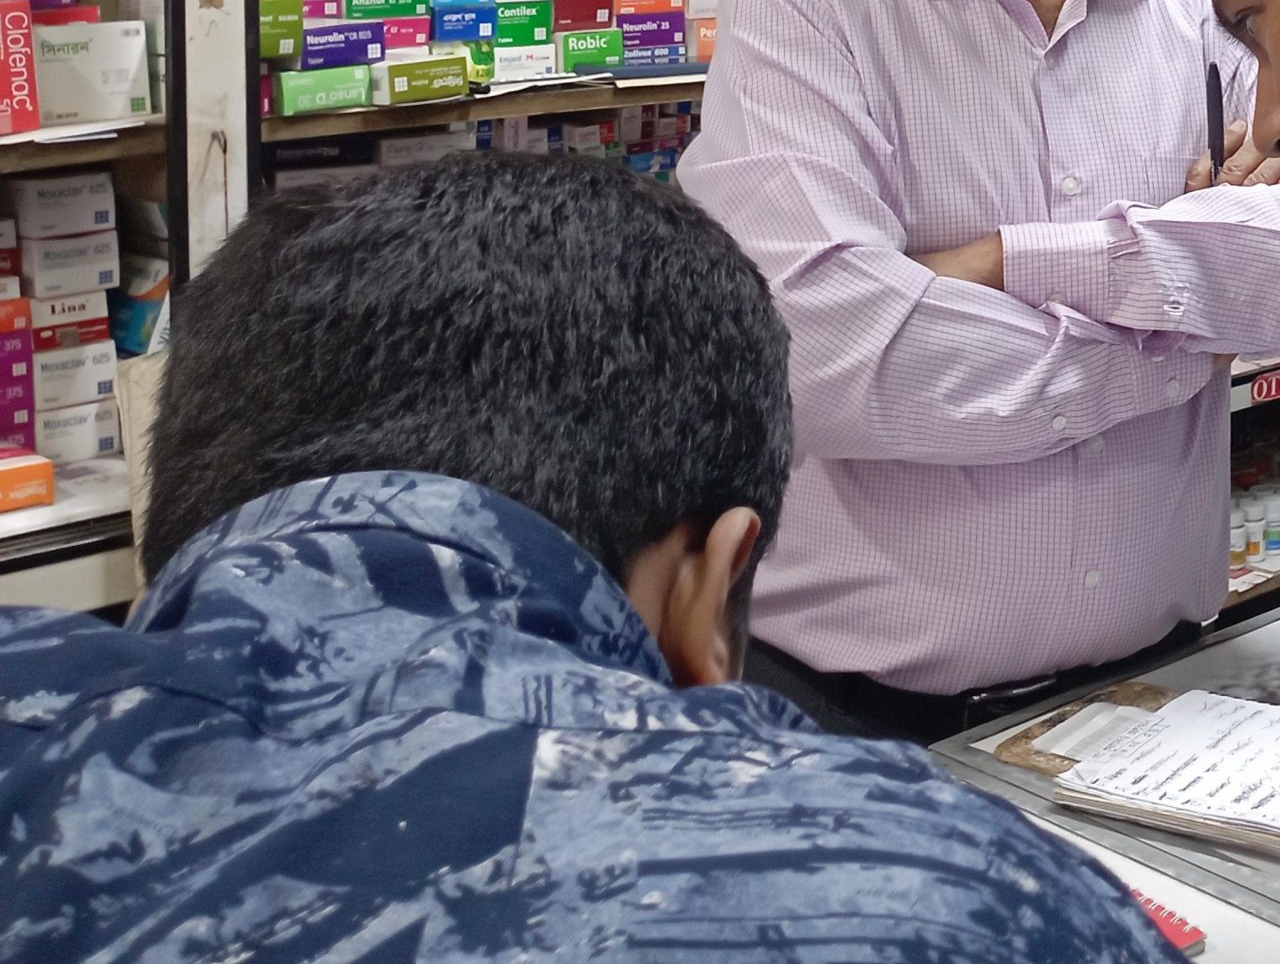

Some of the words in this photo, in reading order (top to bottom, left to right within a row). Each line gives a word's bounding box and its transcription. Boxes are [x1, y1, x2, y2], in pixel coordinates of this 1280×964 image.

[497, 7, 538, 18] Contilex
[622, 21, 658, 32] Neurolin
[661, 21, 670, 31] 25
[306, 32, 346, 45] Neurolin
[568, 36, 608, 50] Robic
[654, 47, 669, 56] 600
[5, 11, 33, 111] Clofenac
[315, 93, 327, 105] D
[330, 87, 366, 106] Lanso
[37, 187, 84, 200] Moxaclav
[43, 245, 89, 261] Moxaclav
[50, 302, 87, 316] Lina
[40, 356, 88, 373] Moxaclav
[92, 354, 112, 366] 625
[43, 413, 90, 430] Moxaclav
[94, 409, 114, 423] 625
